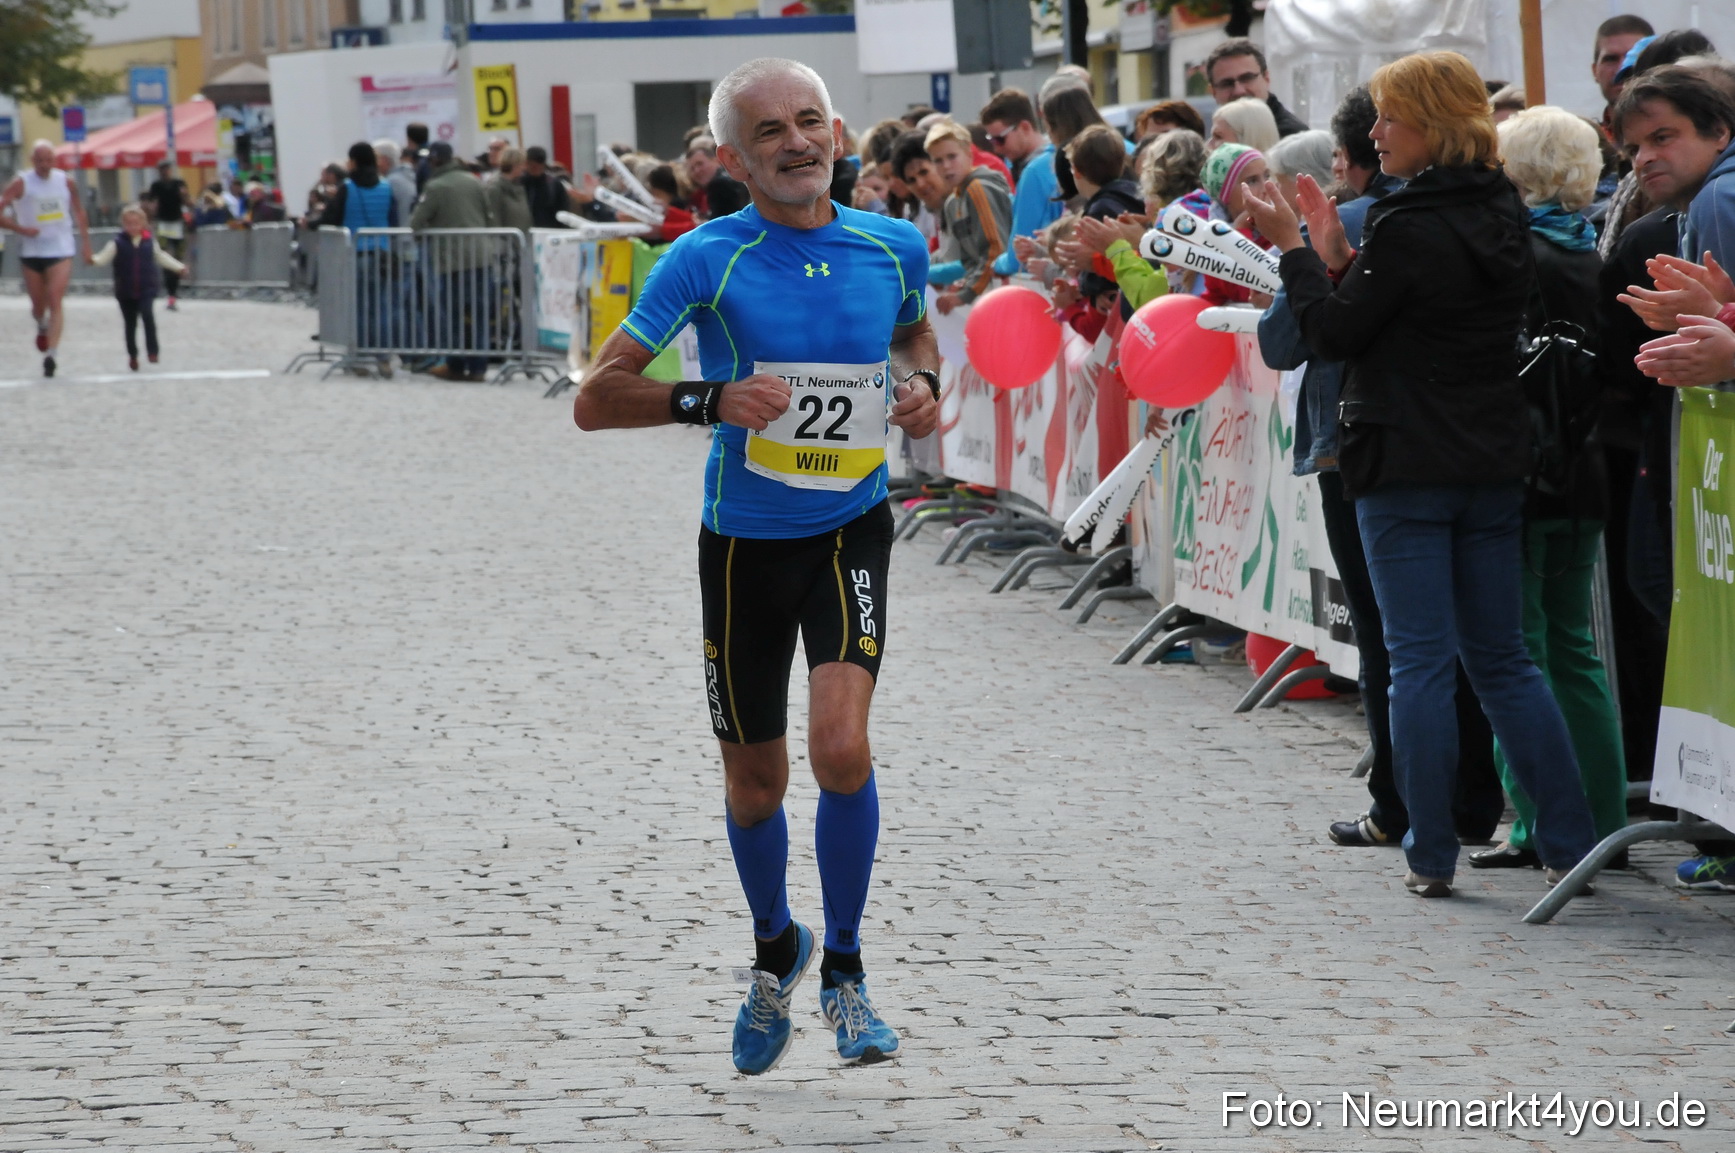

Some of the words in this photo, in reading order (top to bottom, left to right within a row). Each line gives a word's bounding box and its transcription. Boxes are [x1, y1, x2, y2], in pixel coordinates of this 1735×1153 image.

[485, 85, 509, 117] D
[807, 376, 870, 389] Neumarkt
[793, 394, 853, 441] 22
[796, 452, 839, 472] Willi
[1703, 438, 1724, 491] Der
[850, 568, 876, 638] SKINS
[704, 661, 728, 731] SKINS
